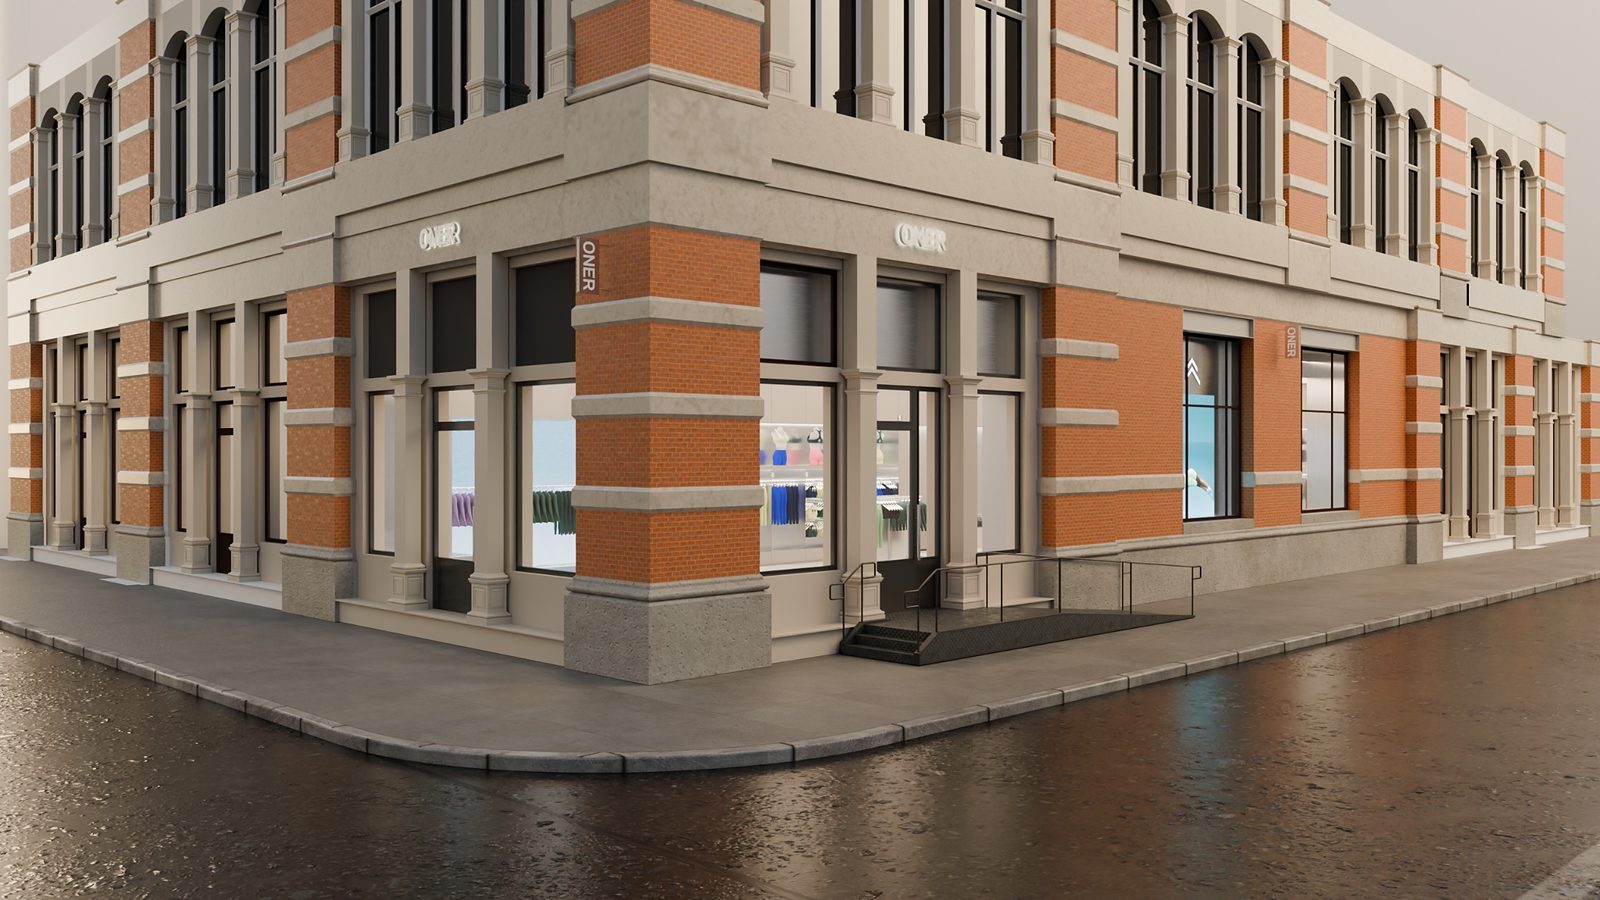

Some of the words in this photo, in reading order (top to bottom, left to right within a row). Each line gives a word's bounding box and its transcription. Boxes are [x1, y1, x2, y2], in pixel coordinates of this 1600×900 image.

[420, 222, 460, 250] ONER
[895, 224, 946, 253] ONER
[582, 240, 596, 291] ONER
[1286, 326, 1297, 358] ONER
